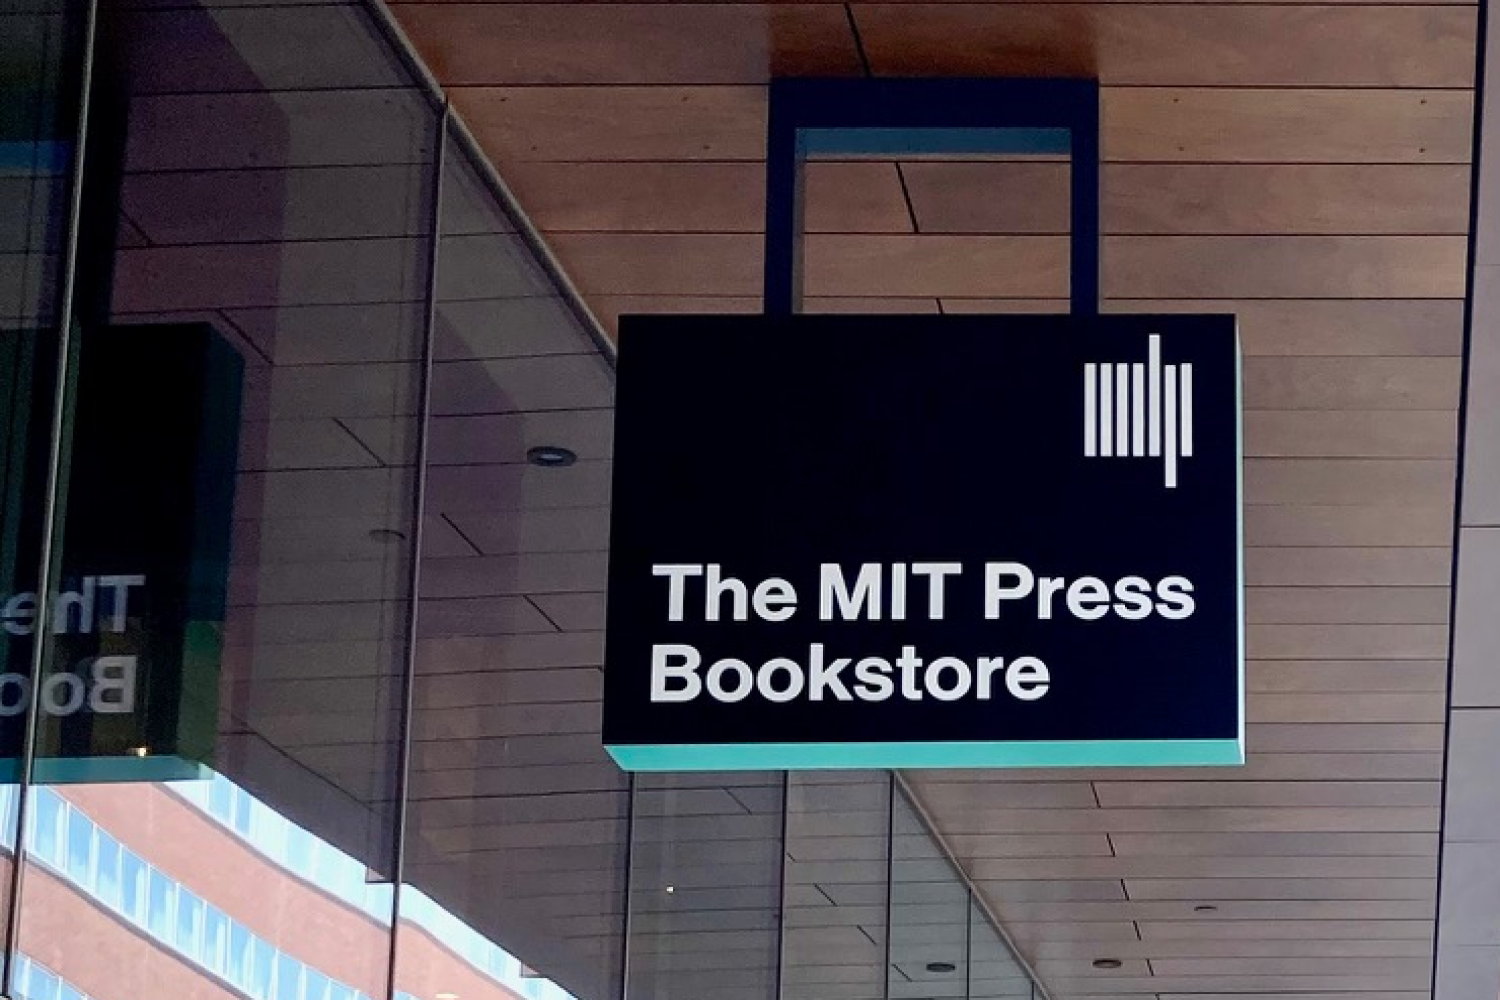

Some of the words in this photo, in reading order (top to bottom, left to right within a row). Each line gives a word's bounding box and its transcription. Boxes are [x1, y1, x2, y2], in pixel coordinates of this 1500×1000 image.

[651, 563, 798, 622] The
[818, 562, 962, 621] MIT
[984, 561, 1196, 620] Press
[650, 642, 1051, 703] Bookstore
